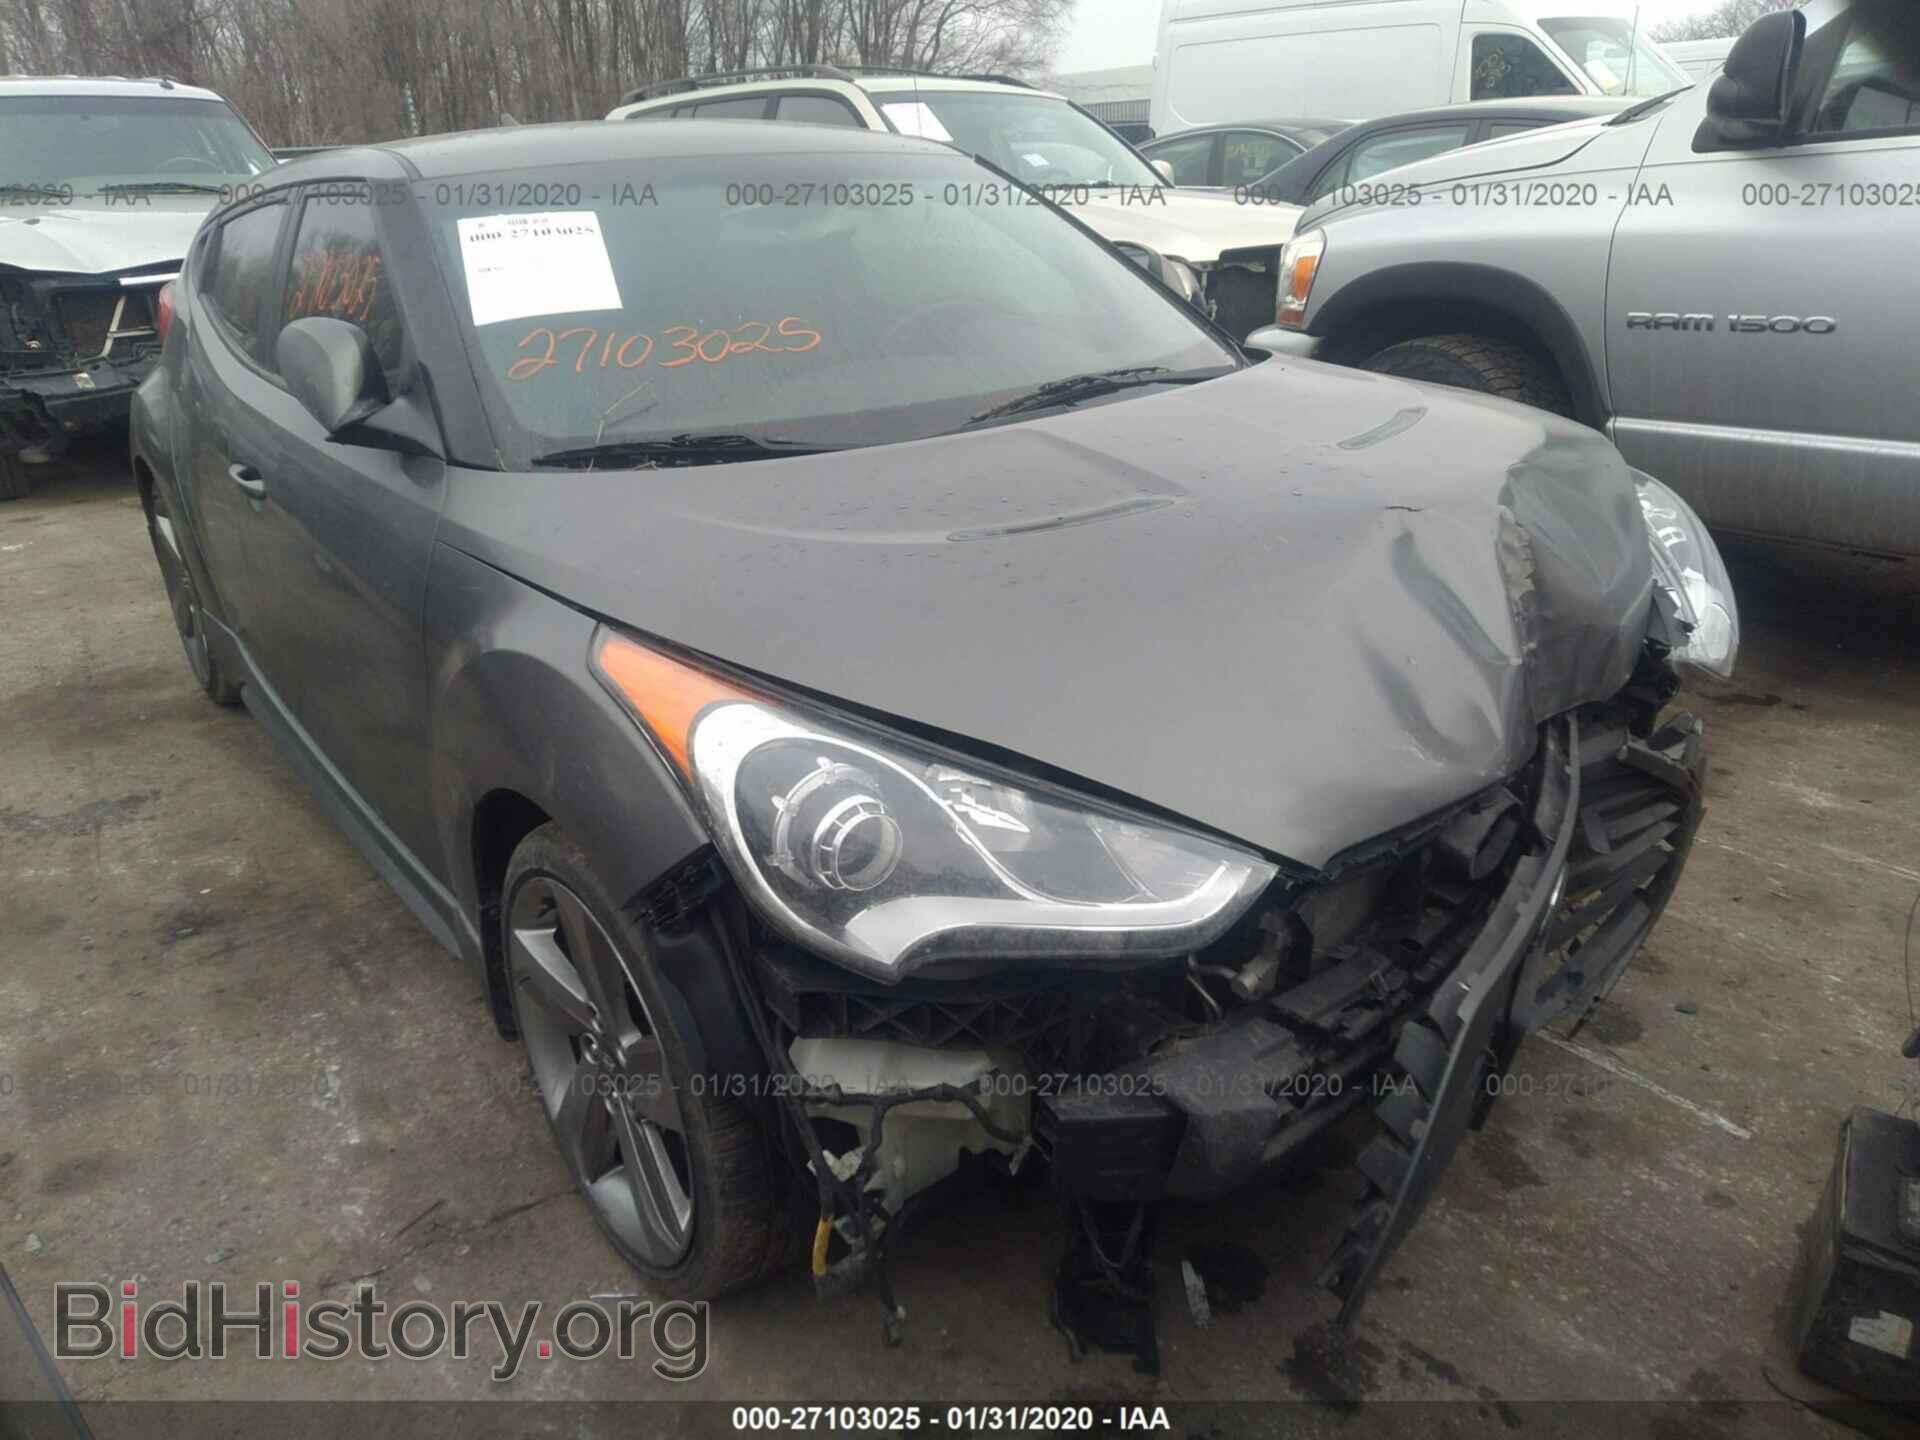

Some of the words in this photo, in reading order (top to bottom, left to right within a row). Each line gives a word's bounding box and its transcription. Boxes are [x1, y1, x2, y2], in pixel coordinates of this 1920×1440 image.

[1626, 312, 1715, 332] RAM
[1728, 314, 1837, 335] 1500
[507, 317, 821, 381] 27103025
